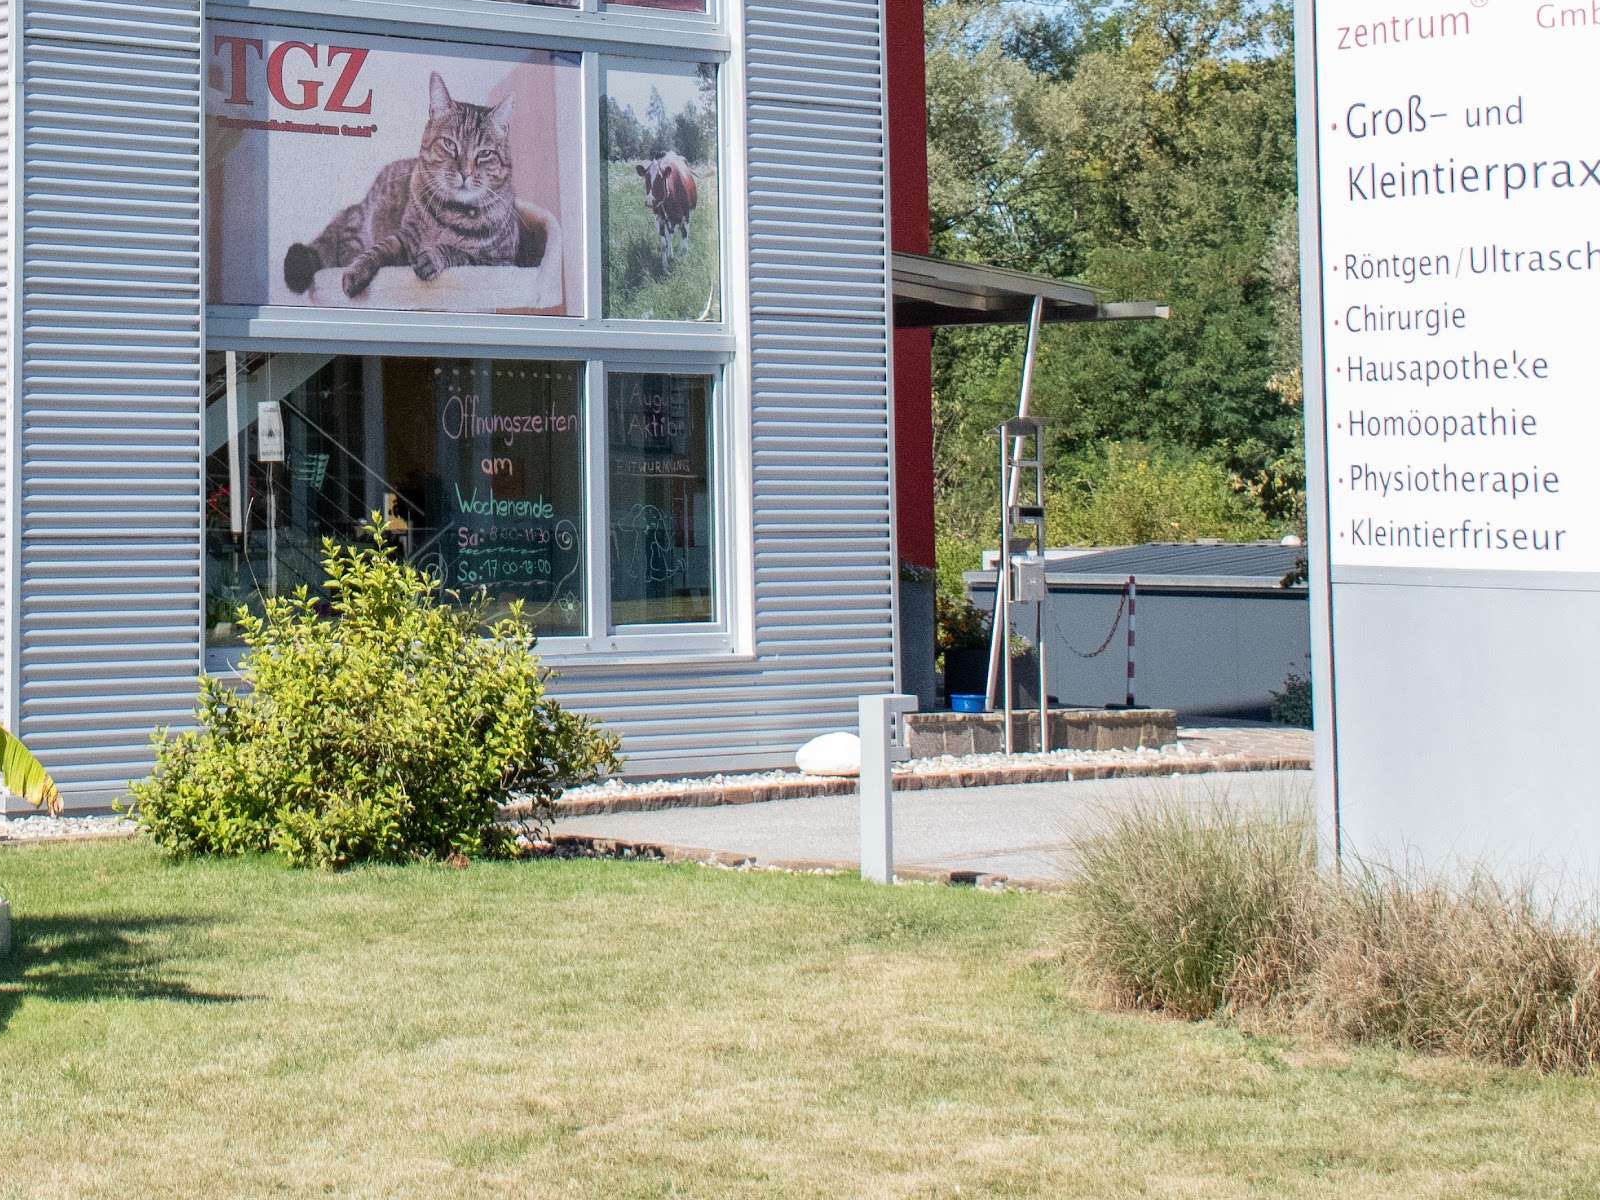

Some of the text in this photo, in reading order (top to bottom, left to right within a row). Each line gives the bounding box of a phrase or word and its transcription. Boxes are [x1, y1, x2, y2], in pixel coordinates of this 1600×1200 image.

[214, 35, 373, 115] TGZ
[1465, 96, 1524, 128] und
[1348, 158, 1600, 201] Kleintierprax
[1345, 302, 1467, 336] Chirurgie
[1346, 350, 1549, 386] Hausapotheke
[442, 385, 578, 447] Öffnungszeiten
[1348, 408, 1538, 442] Homöopathie
[481, 456, 513, 476] am
[1350, 464, 1560, 499] Physiotherapie
[455, 482, 554, 519] Wochenende
[1351, 517, 1567, 551] Kleintierfriseur
